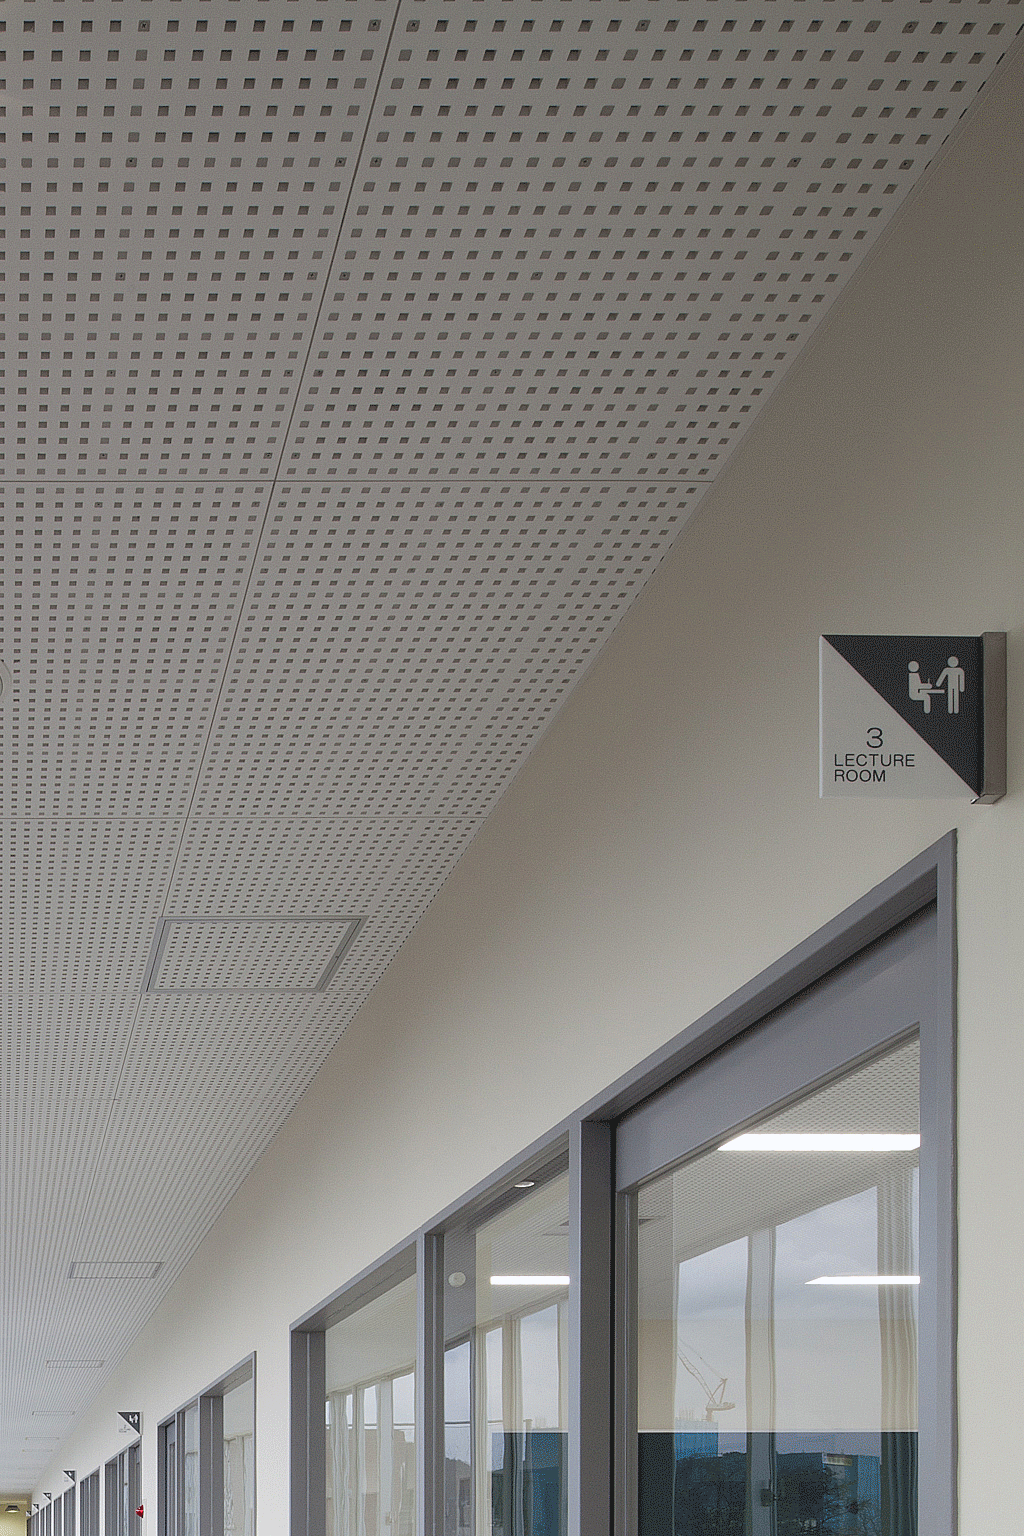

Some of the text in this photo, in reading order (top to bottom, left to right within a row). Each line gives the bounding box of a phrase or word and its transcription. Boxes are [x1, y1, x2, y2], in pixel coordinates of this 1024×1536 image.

[866, 727, 884, 749] 3
[834, 753, 915, 767] LECTURE
[834, 769, 886, 783] ROOM
